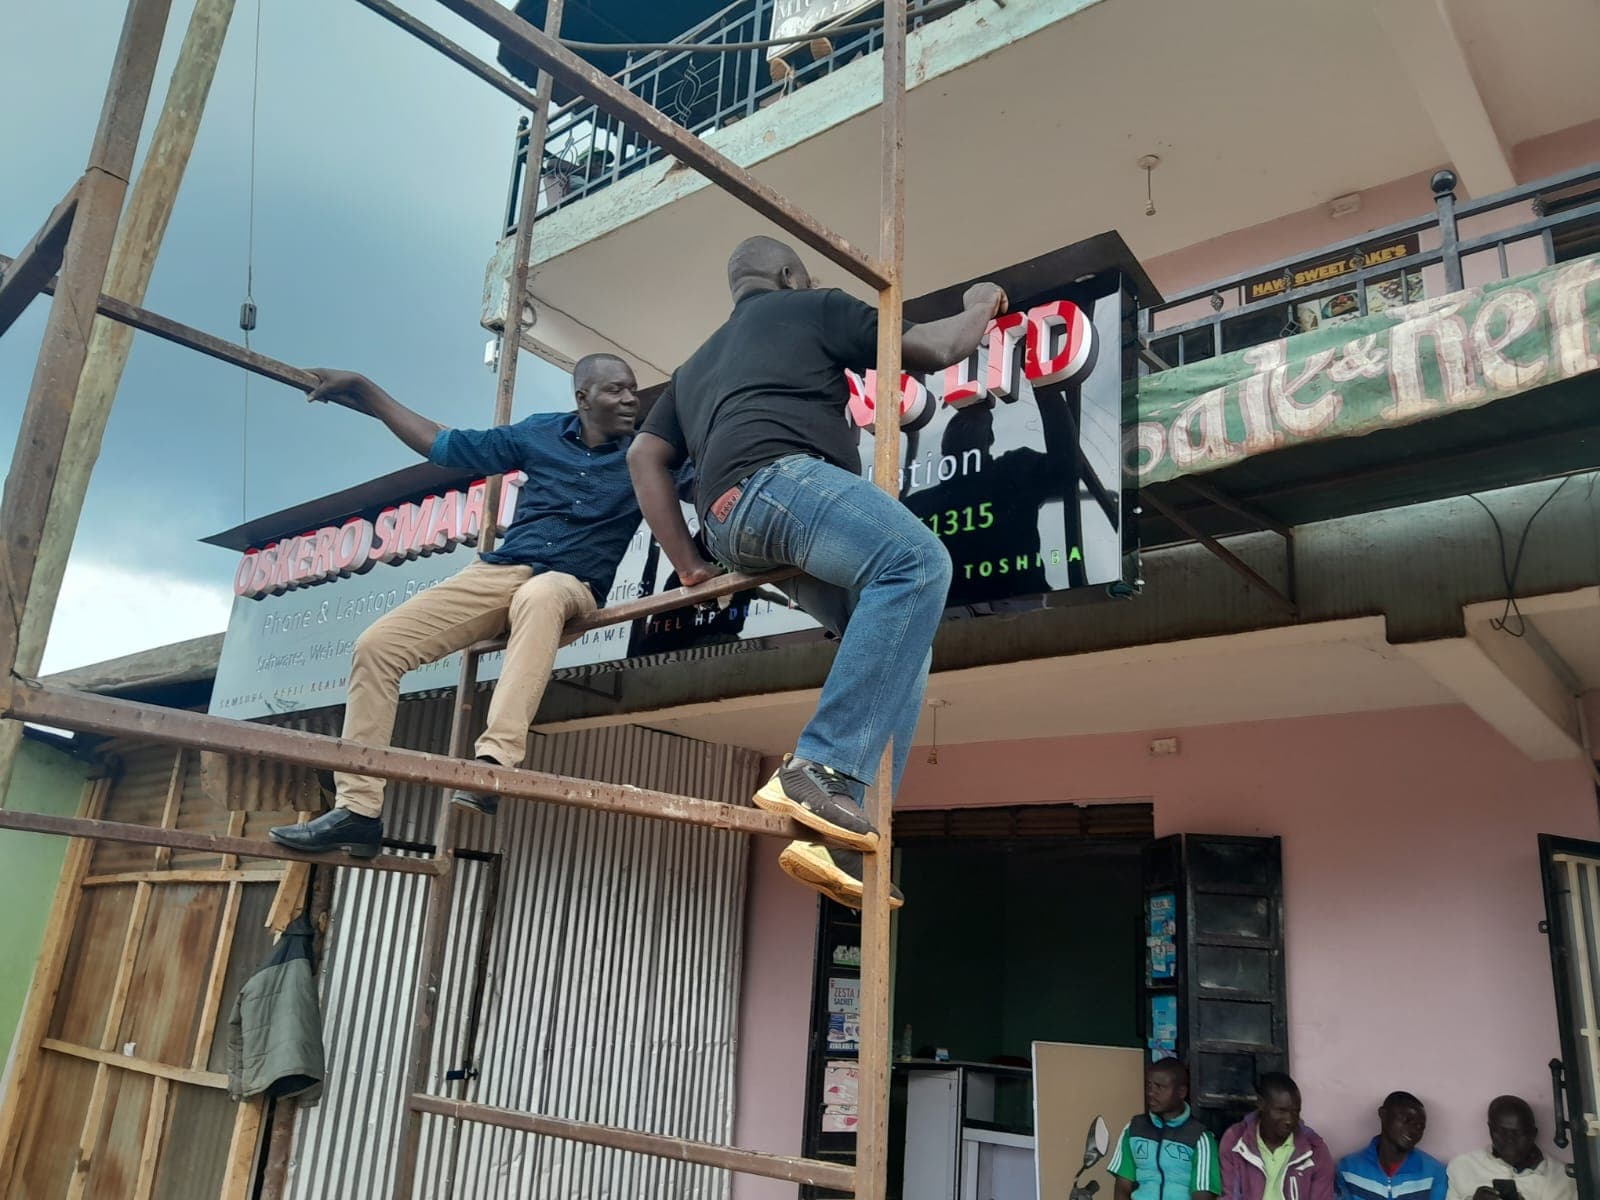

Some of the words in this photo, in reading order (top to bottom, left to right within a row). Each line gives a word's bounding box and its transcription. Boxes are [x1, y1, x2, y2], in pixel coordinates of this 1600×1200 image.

[1294, 261, 1347, 286] SWEET
[233, 516, 374, 598] OSKERO
[369, 469, 528, 565] SMART
[943, 299, 1094, 411] LTD
[695, 611, 716, 626] HP
[729, 601, 773, 621] DELL
[963, 546, 1081, 579] TOSHIBA
[262, 608, 313, 638] Phone
[317, 600, 330, 625] &
[336, 588, 397, 621] Laptop
[310, 641, 333, 661] Web
